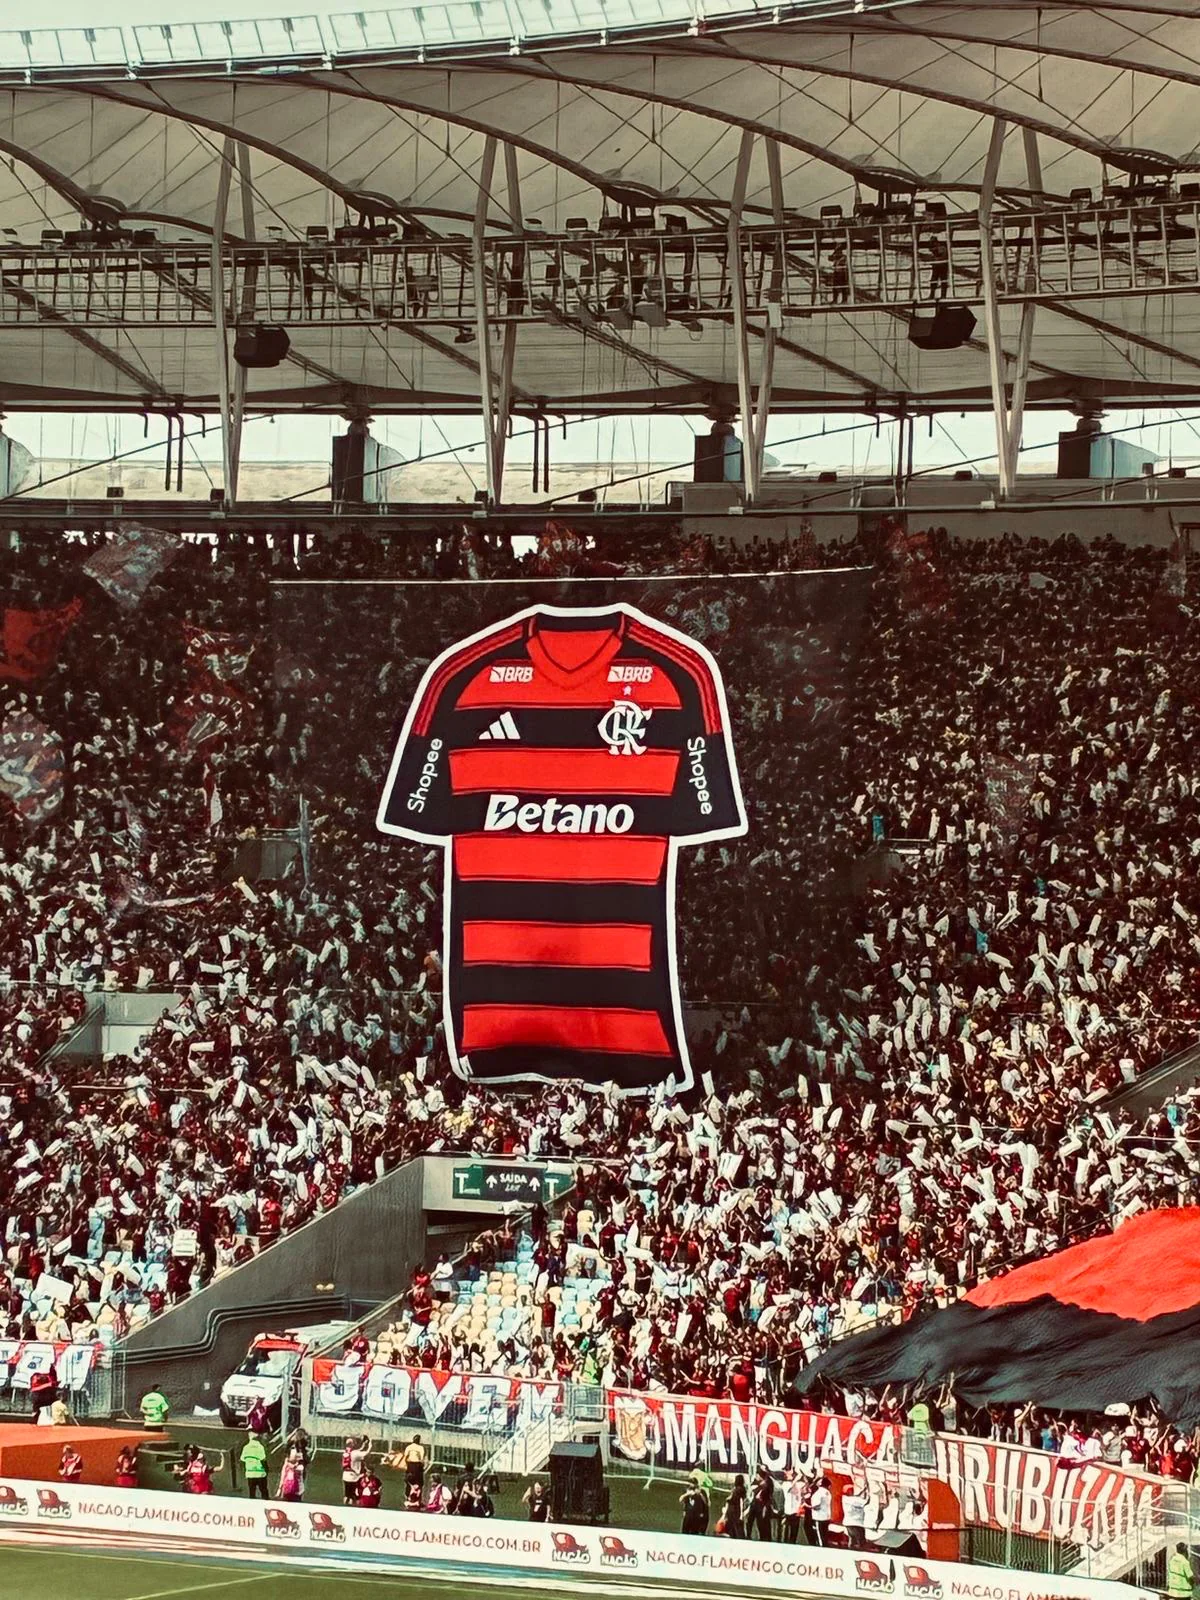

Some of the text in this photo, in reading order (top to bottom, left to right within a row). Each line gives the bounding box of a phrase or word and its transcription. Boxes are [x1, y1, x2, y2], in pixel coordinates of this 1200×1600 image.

[504, 666, 534, 683] BRB
[622, 666, 653, 683] BRB
[408, 738, 443, 813] Shopee
[686, 736, 713, 815] Shopee
[484, 795, 634, 833] Betano
[78, 1501, 256, 1528] NACAO.FLAMENGO.COM.BR
[352, 1526, 542, 1553] NACAO.FLAMENGO.COM.BR
[645, 1551, 845, 1581] NACAO.FLAMENGO.COM.BR
